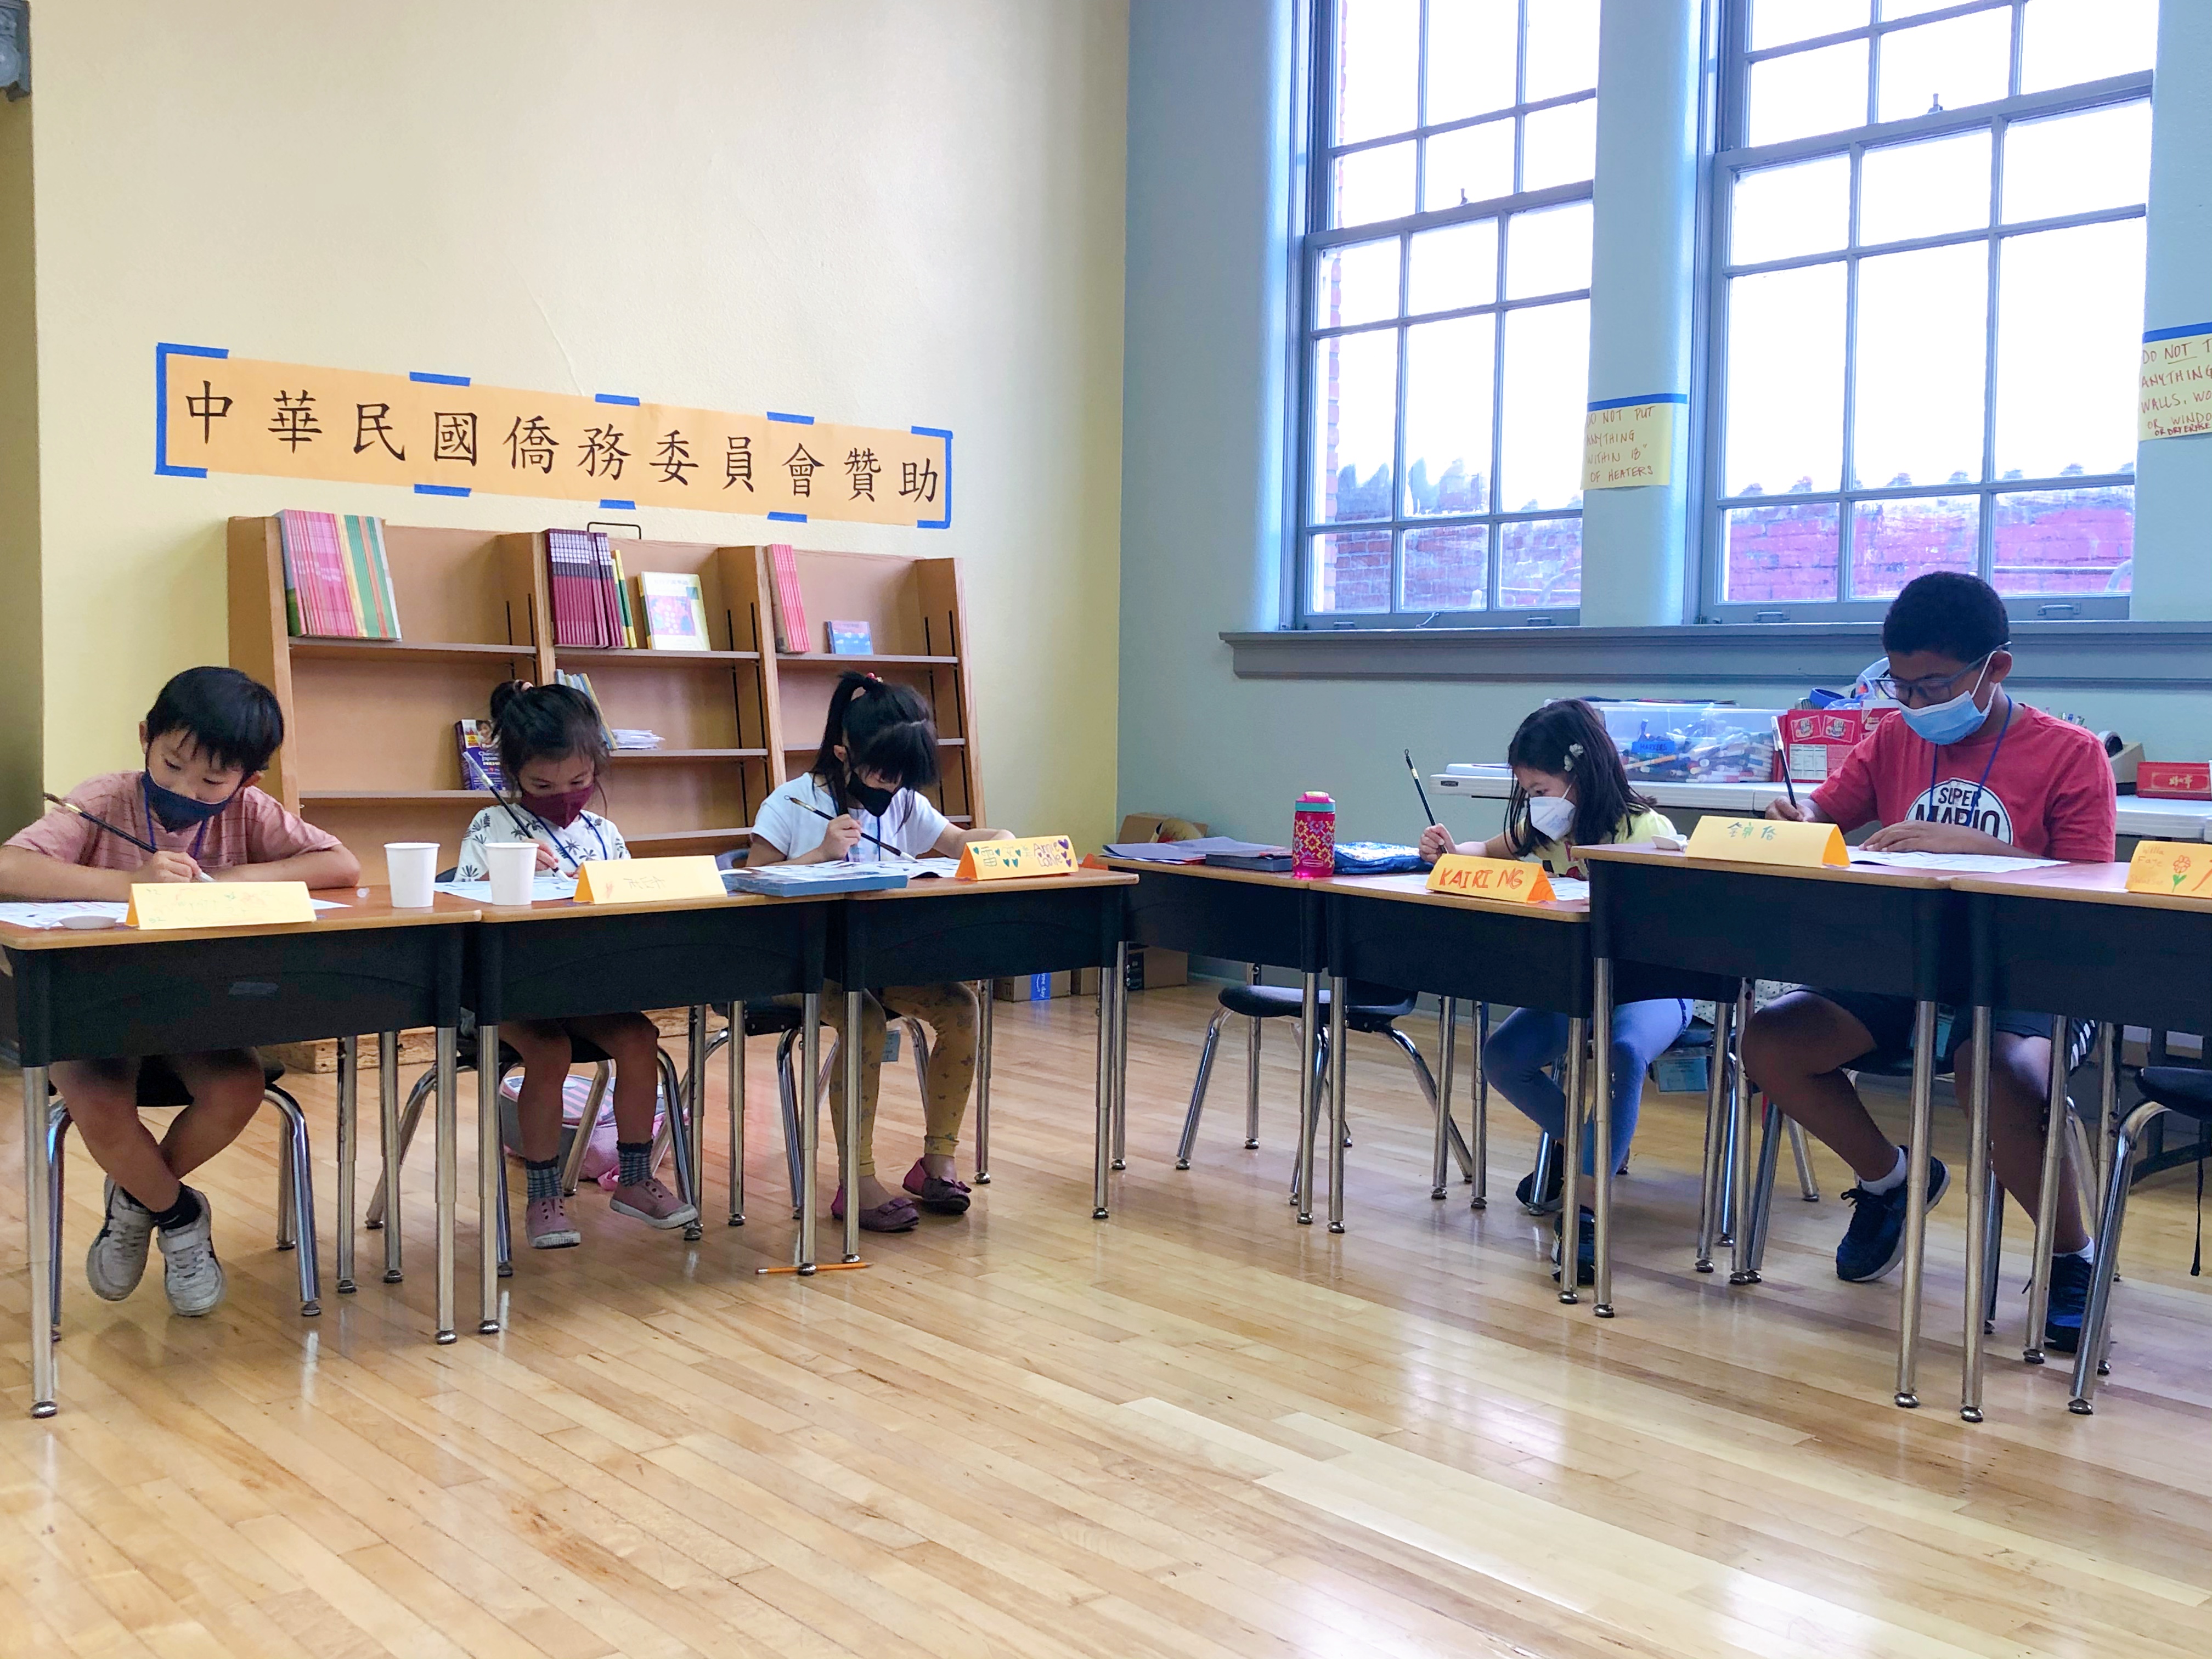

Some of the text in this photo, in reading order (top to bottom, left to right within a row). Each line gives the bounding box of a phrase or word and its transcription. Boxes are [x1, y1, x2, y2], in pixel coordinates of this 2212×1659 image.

[2142, 349, 2157, 364] DO
[2165, 342, 2193, 360] NOT
[1602, 410, 1623, 424] NOT
[1634, 406, 1656, 421] PUT
[2147, 412, 2212, 430] OR WINDO
[1587, 430, 1635, 447] ANYTHING
[2167, 426, 2182, 436] DRY
[185, 379, 938, 503] 中華民國僑務委員會贊助
[1590, 465, 1654, 483] OF HEATERS
[1497, 867, 1524, 889] NG
